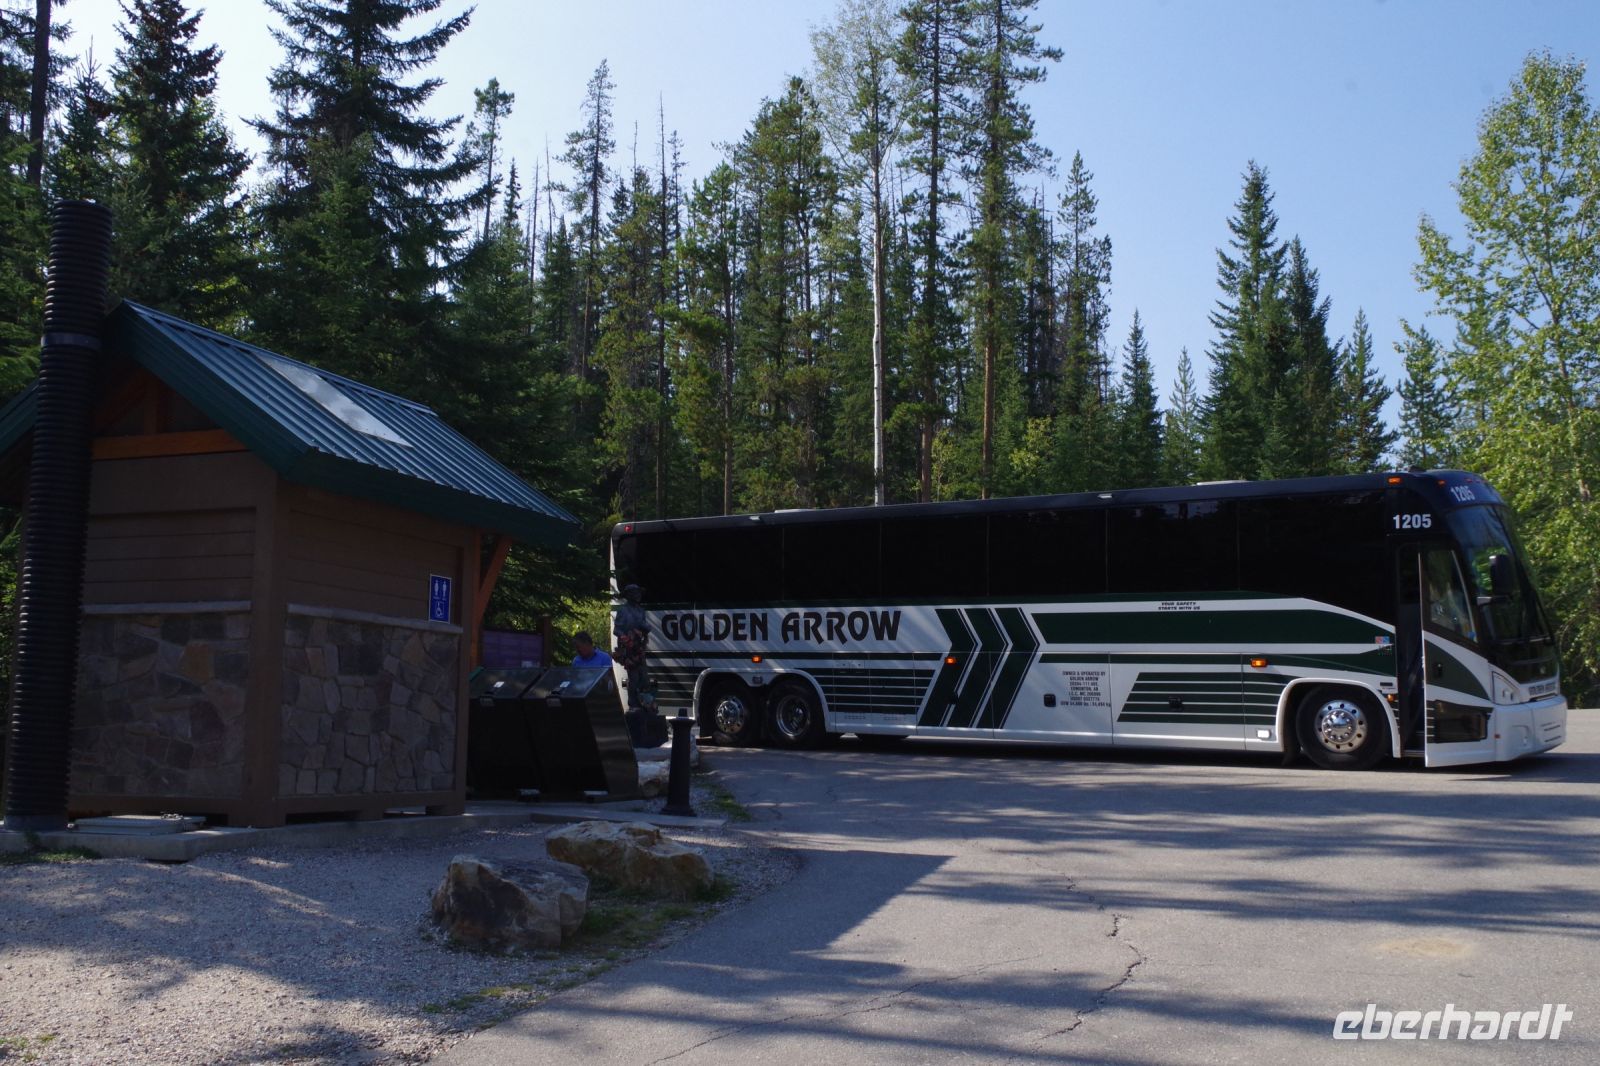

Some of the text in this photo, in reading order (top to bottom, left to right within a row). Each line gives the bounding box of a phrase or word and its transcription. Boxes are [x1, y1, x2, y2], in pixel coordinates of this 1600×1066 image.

[1450, 485, 1476, 502] 1205
[1393, 513, 1432, 529] 1205
[661, 610, 902, 645] GOLDEN ARROW
